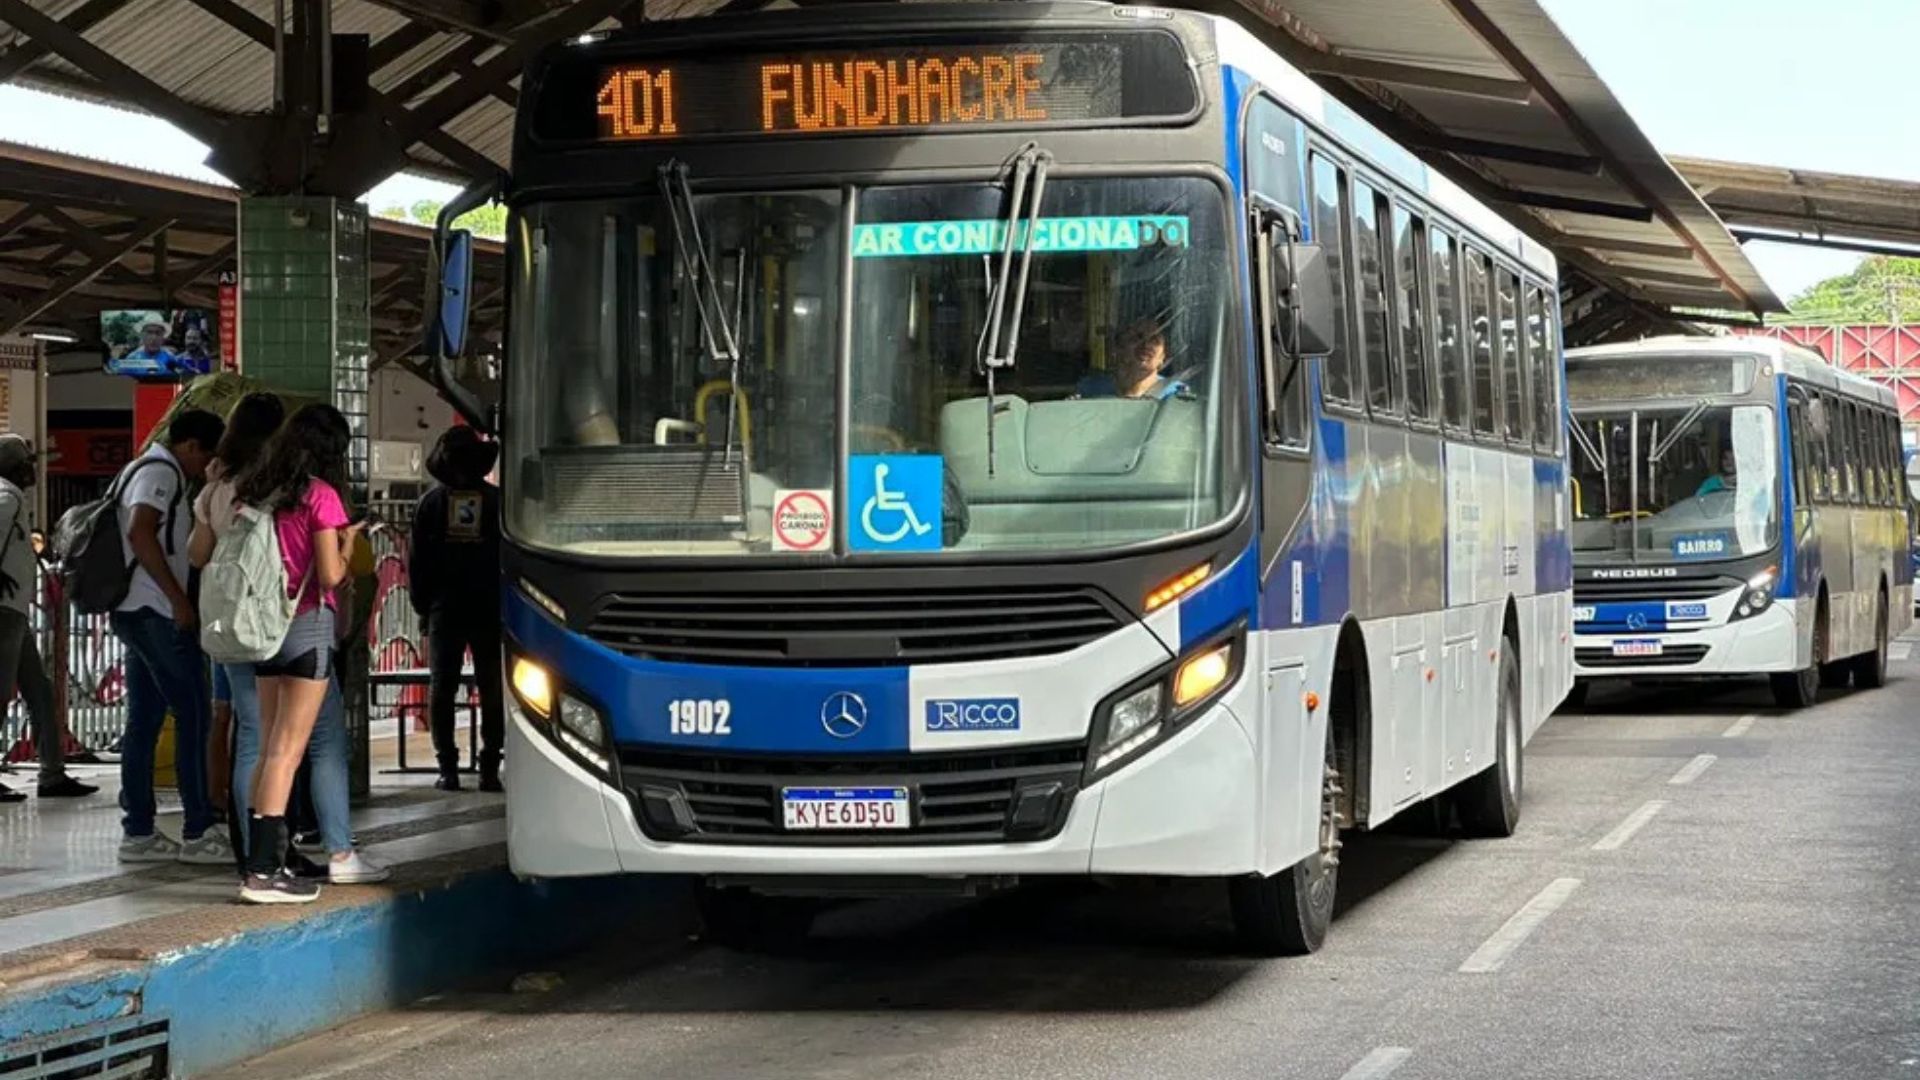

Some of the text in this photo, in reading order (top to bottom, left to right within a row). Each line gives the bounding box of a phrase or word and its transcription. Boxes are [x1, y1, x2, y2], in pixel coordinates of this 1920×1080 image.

[597, 55, 1047, 134] 401 FUNDHACRE
[857, 225, 903, 253] AR
[780, 520, 825, 530] CARONA
[1678, 539, 1723, 555] BAIRRO
[1592, 567, 1678, 578] NEOBUS
[668, 699, 731, 734] 1902
[795, 801, 895, 824] KYE6D50
